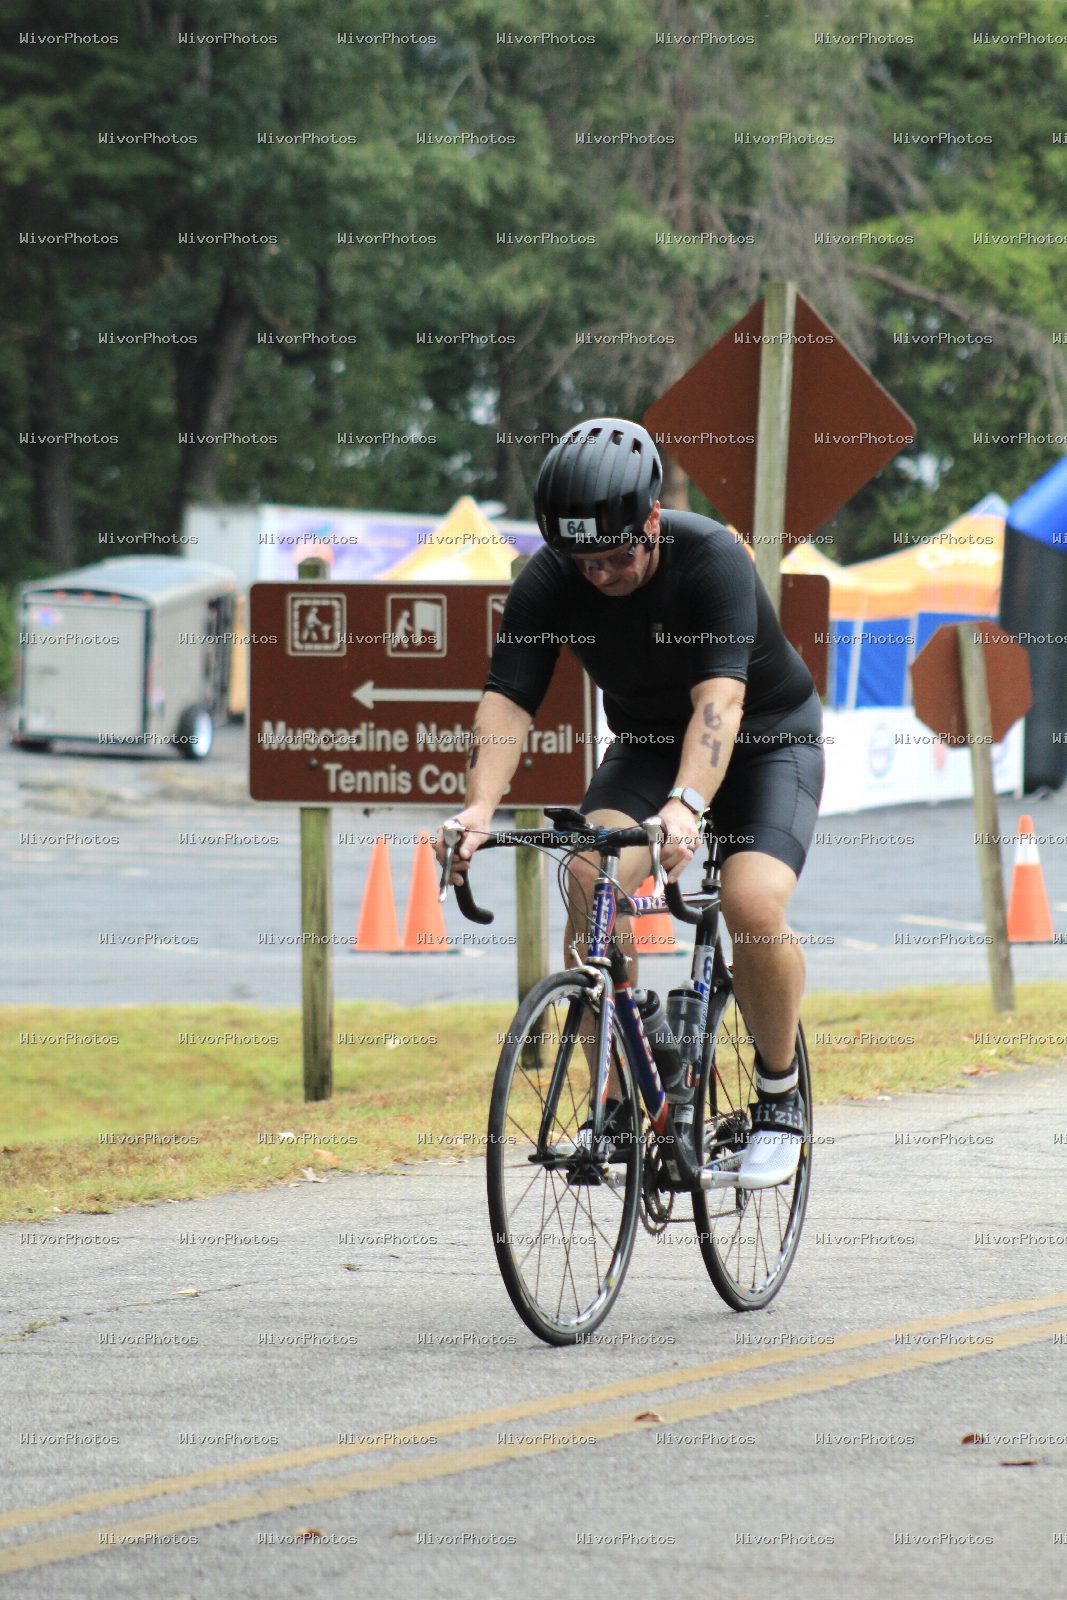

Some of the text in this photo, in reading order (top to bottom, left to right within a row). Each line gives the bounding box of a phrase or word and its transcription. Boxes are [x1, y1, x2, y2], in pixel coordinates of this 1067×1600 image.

[566, 520, 586, 536] 64
[416, 722, 471, 753] Nat
[700, 702, 721, 768] 64
[323, 763, 511, 796] Tennis Cou
[634, 896, 667, 910] TRE
